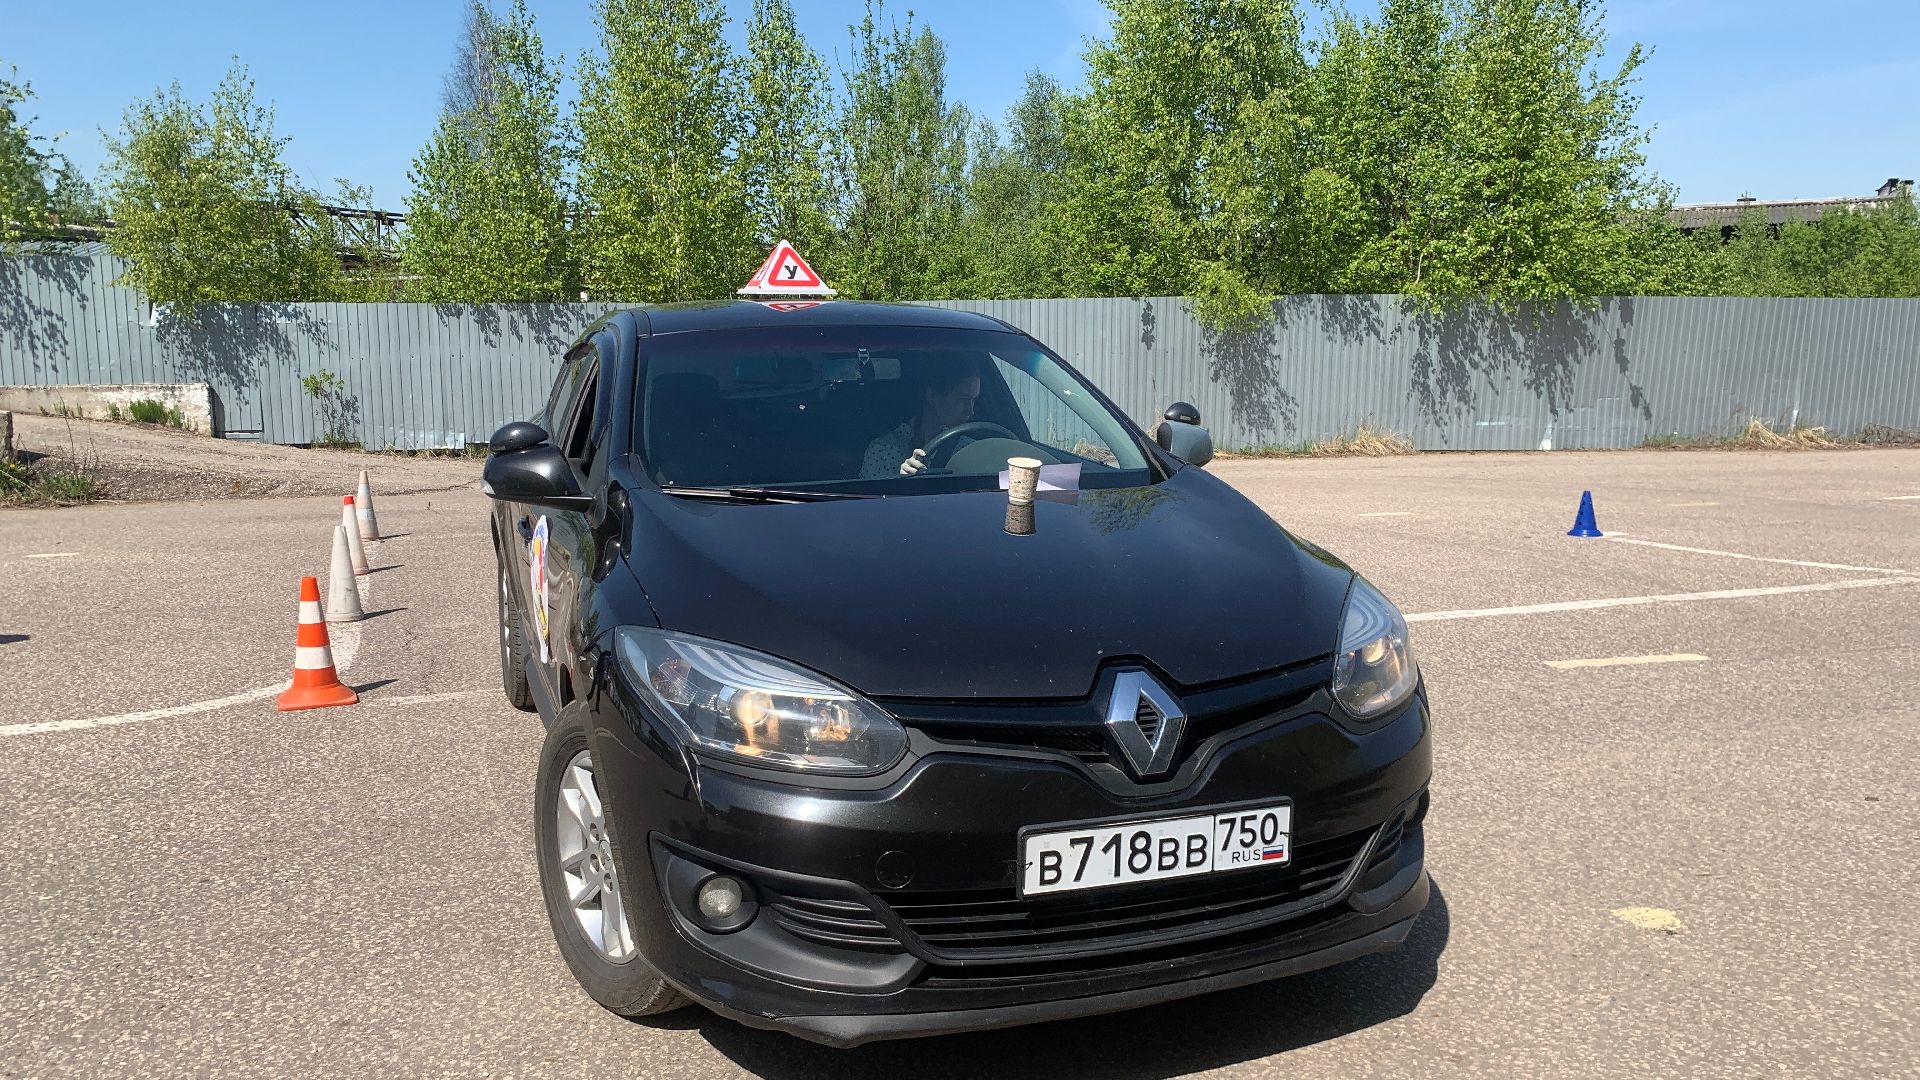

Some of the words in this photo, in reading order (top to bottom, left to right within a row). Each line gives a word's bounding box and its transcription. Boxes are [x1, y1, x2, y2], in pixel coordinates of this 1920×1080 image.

[784, 265, 798, 280] У
[1218, 812, 1279, 852] 750
[1231, 849, 1261, 863] RUS
